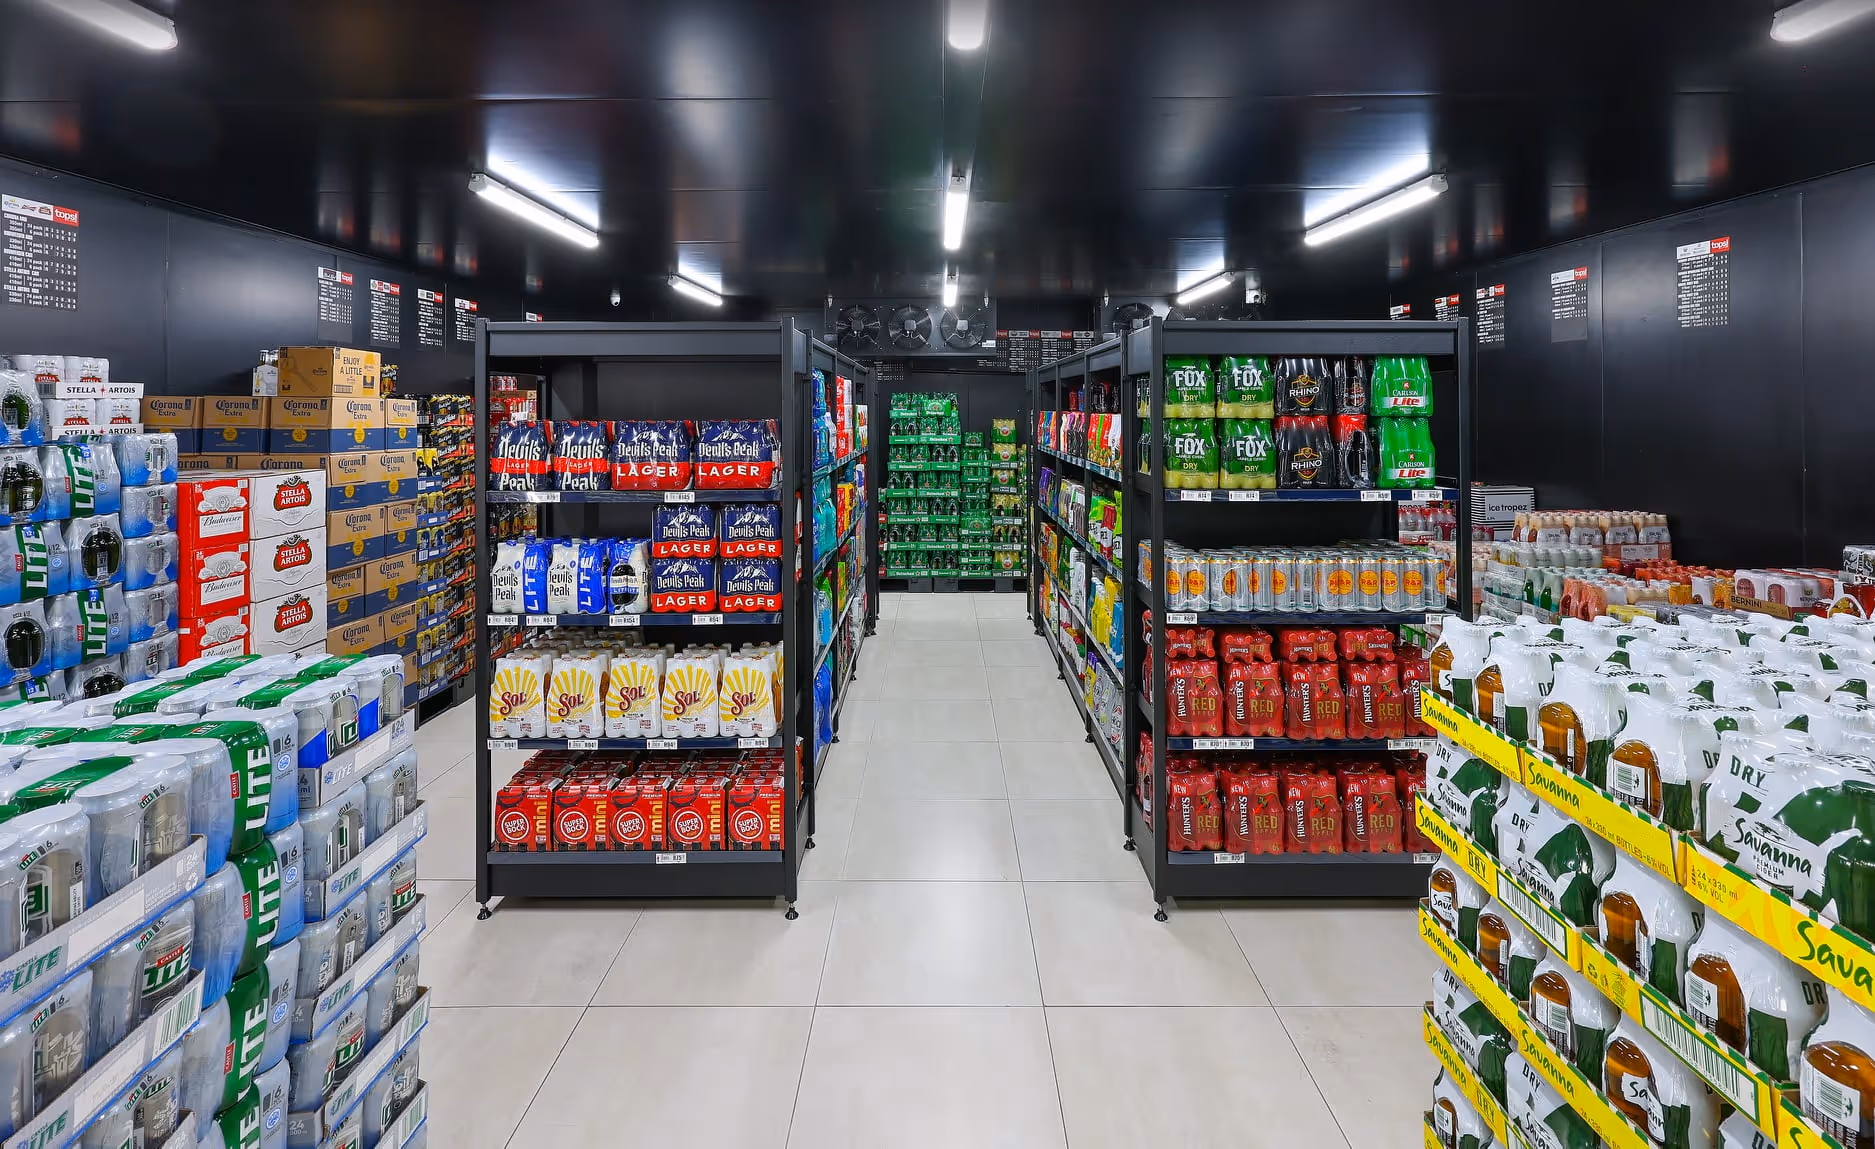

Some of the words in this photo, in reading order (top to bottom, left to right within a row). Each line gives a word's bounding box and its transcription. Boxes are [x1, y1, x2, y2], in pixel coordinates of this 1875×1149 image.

[343, 356, 361, 366] ENJOY
[340, 366, 345, 375] A
[346, 366, 363, 376] LITTLE
[1232, 369, 1263, 387] FOX
[1173, 370, 1206, 387] FOX
[66, 386, 97, 394] STELLA
[1289, 386, 1320, 398] RHINO
[1391, 397, 1420, 406] Lite
[618, 442, 651, 458] Devil's
[652, 442, 678, 457] Peak
[698, 442, 732, 458] Devil's
[734, 441, 759, 457] Peak
[1175, 437, 1206, 455] FOX
[1236, 440, 1267, 457] FOX
[178, 459, 209, 470] orona
[380, 452, 405, 467] Corona
[1291, 459, 1323, 471] RHINO
[1398, 460, 1425, 468] CARLSON
[617, 465, 679, 477] LAGER
[698, 465, 760, 477] LAGER
[1398, 469, 1426, 478] Lite
[280, 489, 305, 498] STELLA
[280, 495, 306, 505] ARTOIS
[1488, 503, 1500, 511] ice
[1501, 503, 1528, 513] tropez
[203, 515, 242, 527] Budweiser
[345, 513, 372, 527] Corona
[662, 525, 688, 538] Devil's
[690, 523, 710, 537] Peak
[728, 526, 755, 539] Devil's
[755, 524, 775, 537] Peak
[280, 547, 305, 558] STELLA
[660, 543, 711, 555] LAGER
[726, 542, 776, 554] LAGER
[280, 554, 306, 566] ARTOIS
[379, 559, 405, 575] Corona
[204, 579, 242, 594] Budweiser
[524, 555, 539, 611] LITE
[580, 555, 594, 607] LITE
[657, 575, 683, 589] Devil's
[684, 574, 705, 589] Peak
[726, 580, 753, 593] Devil's
[754, 578, 774, 592] Peak
[495, 586, 516, 601] Peak
[656, 595, 706, 607] LAGER
[724, 597, 775, 608] LAGER
[1730, 595, 1762, 608] BERNINI
[281, 606, 306, 618] STELLA
[390, 609, 410, 623] Corona
[281, 614, 307, 627] ARTOIS
[84, 600, 107, 656] LITE
[342, 625, 370, 642] Corona
[1353, 672, 1367, 682] NEW
[1410, 679, 1422, 718] HUNTER'S
[1316, 700, 1340, 714] RED
[1379, 703, 1403, 717] RED
[1423, 698, 1459, 733] Savanna
[284, 734, 291, 745] 6
[1702, 750, 1720, 769] DR
[1730, 754, 1766, 788] DRY
[246, 745, 271, 831] LITE
[1173, 785, 1187, 794] NEW
[1527, 760, 1580, 811] Savanna
[1288, 788, 1301, 798] NEW
[533, 801, 548, 833] mini
[592, 800, 607, 833] mini
[648, 800, 663, 833] mini
[706, 800, 721, 833] mini
[767, 799, 781, 833] mini
[1181, 797, 1192, 835] HUNTER'S
[1197, 815, 1220, 828] RED
[1238, 795, 1249, 836] HUNTER'S
[1255, 815, 1278, 829] RED
[1295, 800, 1306, 838] HUNTER'S
[1354, 795, 1365, 835] HUNTER'S
[1370, 814, 1394, 828] RED
[504, 818, 525, 828] SUPER
[507, 824, 526, 834] BOCK
[563, 818, 584, 828] SUPER
[565, 824, 585, 833] BOCK
[619, 818, 641, 828] SUPER
[622, 824, 642, 834] BOCK
[678, 817, 699, 828] SUPER
[681, 823, 700, 834] BOCK
[737, 817, 758, 828] SUPER
[740, 823, 759, 833] BOCK
[1311, 817, 1335, 831] RED
[1511, 812, 1530, 833] DRY
[1418, 805, 1459, 856] Savanna
[1733, 817, 1812, 878] Savanna
[290, 850, 298, 860] 6
[1753, 855, 1785, 876] PREMIUM
[1756, 864, 1779, 880] CIDER
[1696, 879, 1709, 894] 6%
[1710, 887, 1724, 904] VOL
[1728, 890, 1738, 900] ml
[257, 860, 281, 948] LITE
[1422, 916, 1458, 967] Savanna
[158, 946, 183, 965] CASTLE
[12, 945, 62, 995] LITE
[282, 979, 289, 991] 6
[1801, 981, 1825, 1005] DR
[1521, 1029, 1575, 1098] Savanna
[275, 1085, 282, 1098] 6
[289, 1120, 305, 1130] 24
